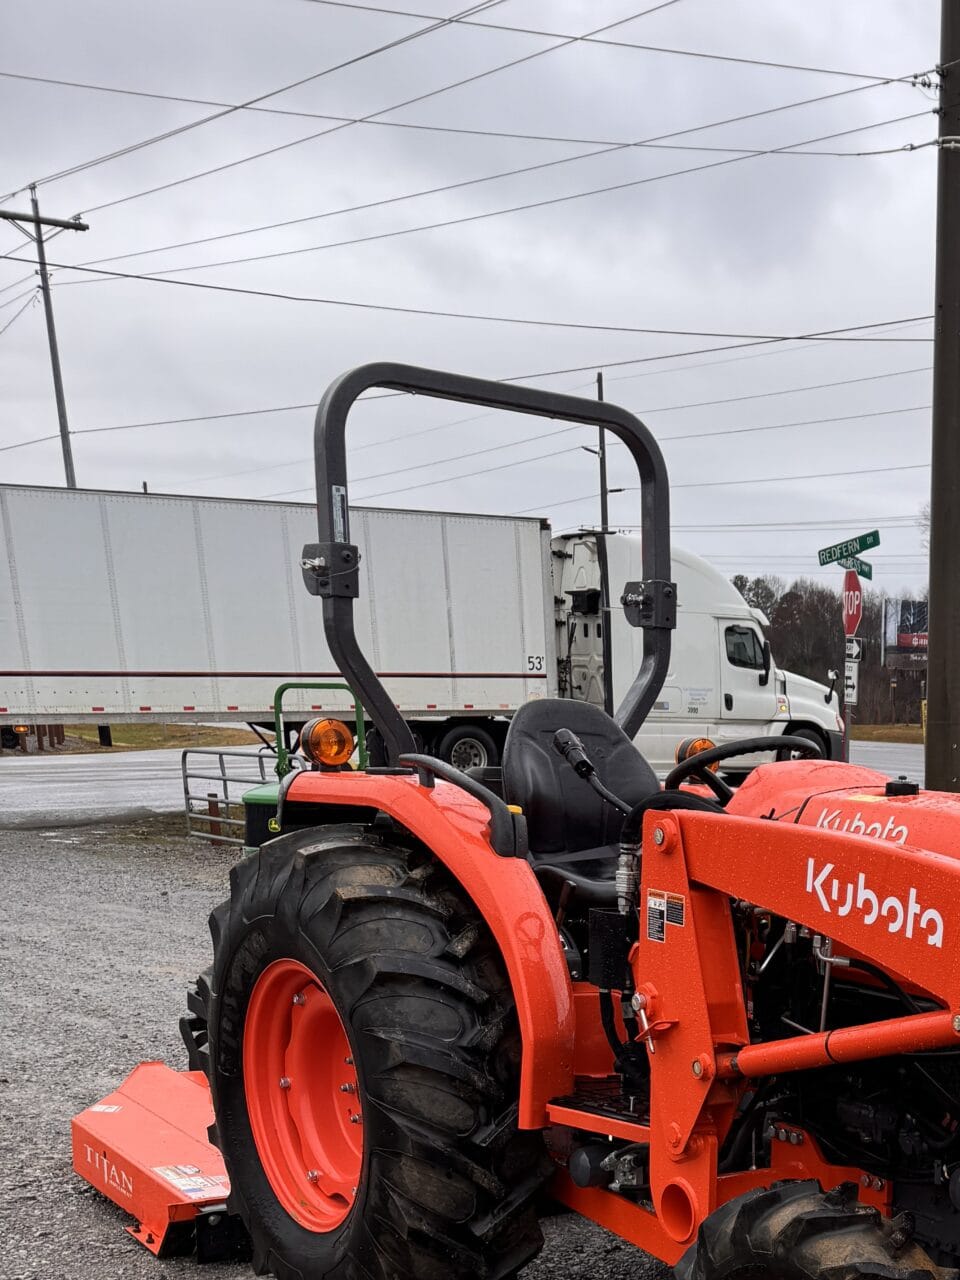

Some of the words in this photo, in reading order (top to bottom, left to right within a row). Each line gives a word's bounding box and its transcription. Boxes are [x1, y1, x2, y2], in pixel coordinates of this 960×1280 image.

[820, 538, 860, 565] REDFERN
[866, 536, 874, 545] DR
[815, 808, 909, 845] Kubota
[805, 857, 944, 949] Kubota
[83, 1143, 133, 1194] TITAN
